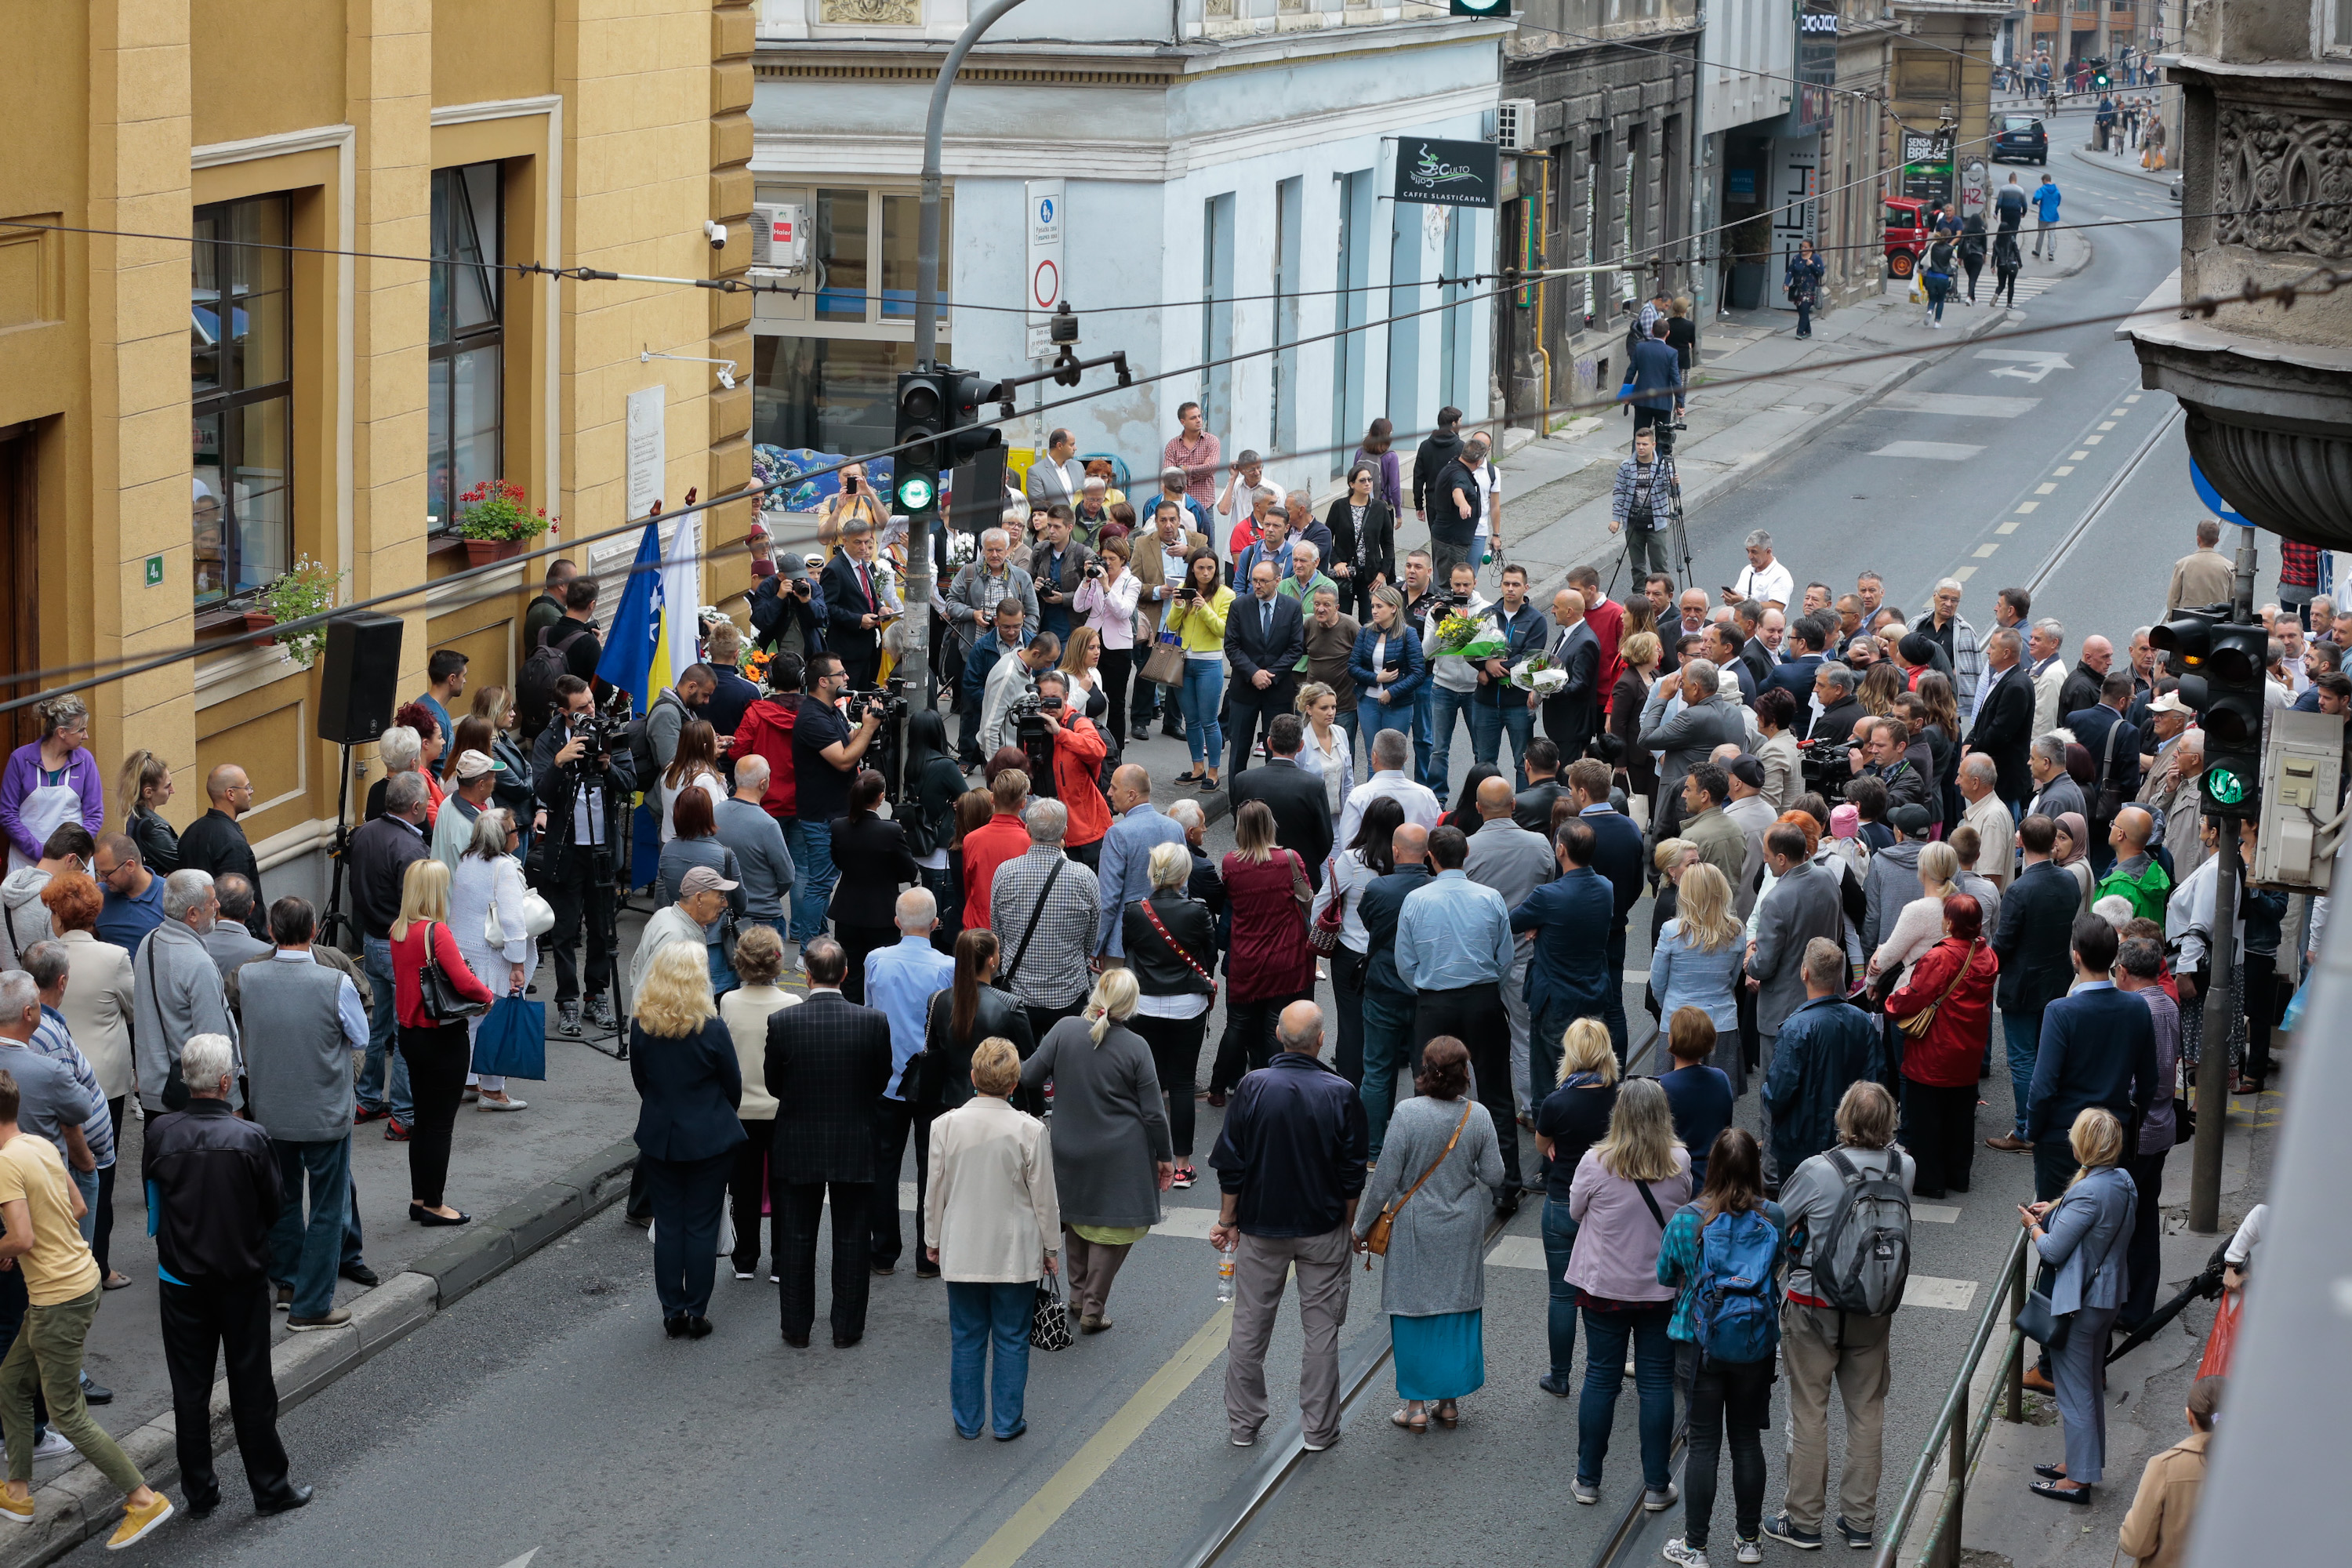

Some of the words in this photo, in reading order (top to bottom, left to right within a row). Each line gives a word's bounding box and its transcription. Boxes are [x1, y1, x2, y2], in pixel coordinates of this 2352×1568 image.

[1439, 163, 1470, 176] CULTO
[1431, 193, 1486, 203] SLASTIČARNA
[1806, 198, 1815, 227] HOTEL
[150, 563, 159, 579] 4a
